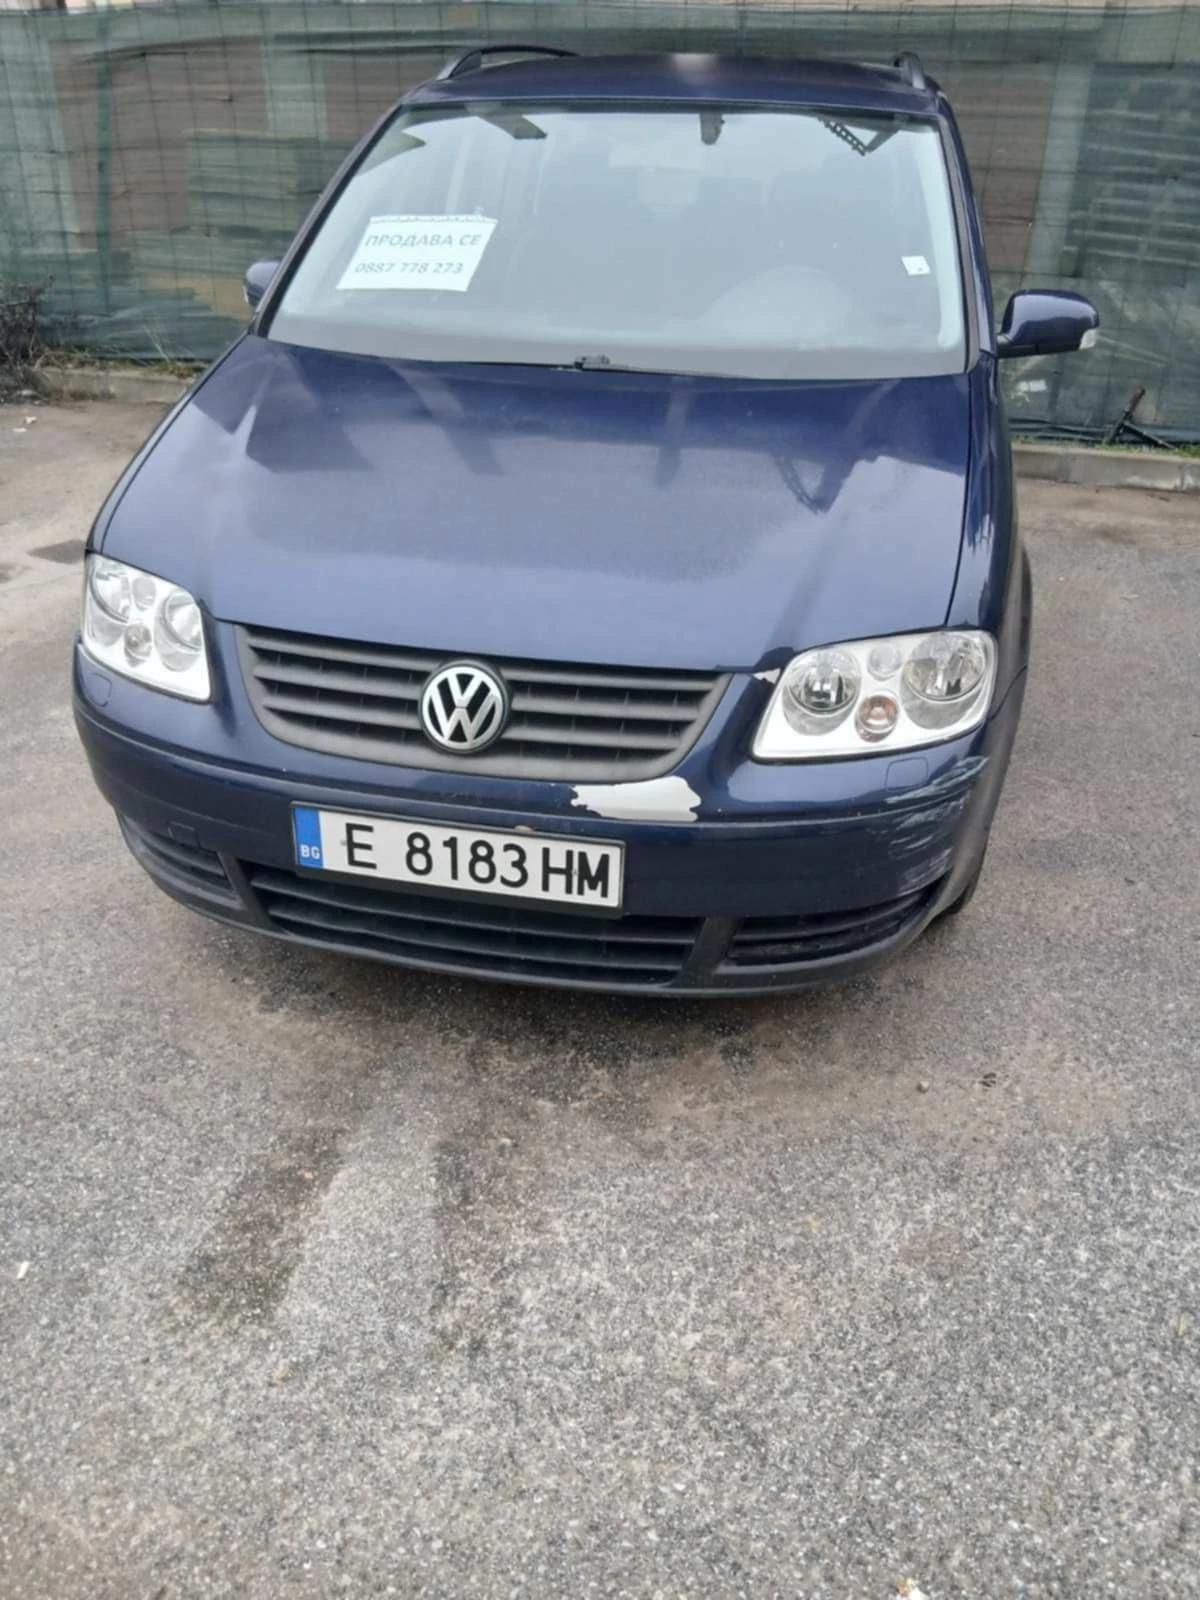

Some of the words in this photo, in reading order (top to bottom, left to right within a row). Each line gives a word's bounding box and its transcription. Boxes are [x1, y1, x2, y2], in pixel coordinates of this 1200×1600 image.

[365, 234, 453, 247] ПРОДАВА
[459, 234, 482, 246] СЕ
[355, 262, 395, 273] 0887
[399, 262, 429, 273] 778
[432, 263, 464, 274] 273
[422, 667, 503, 750] VW
[301, 844, 321, 860] BG
[405, 832, 529, 888] 8183
